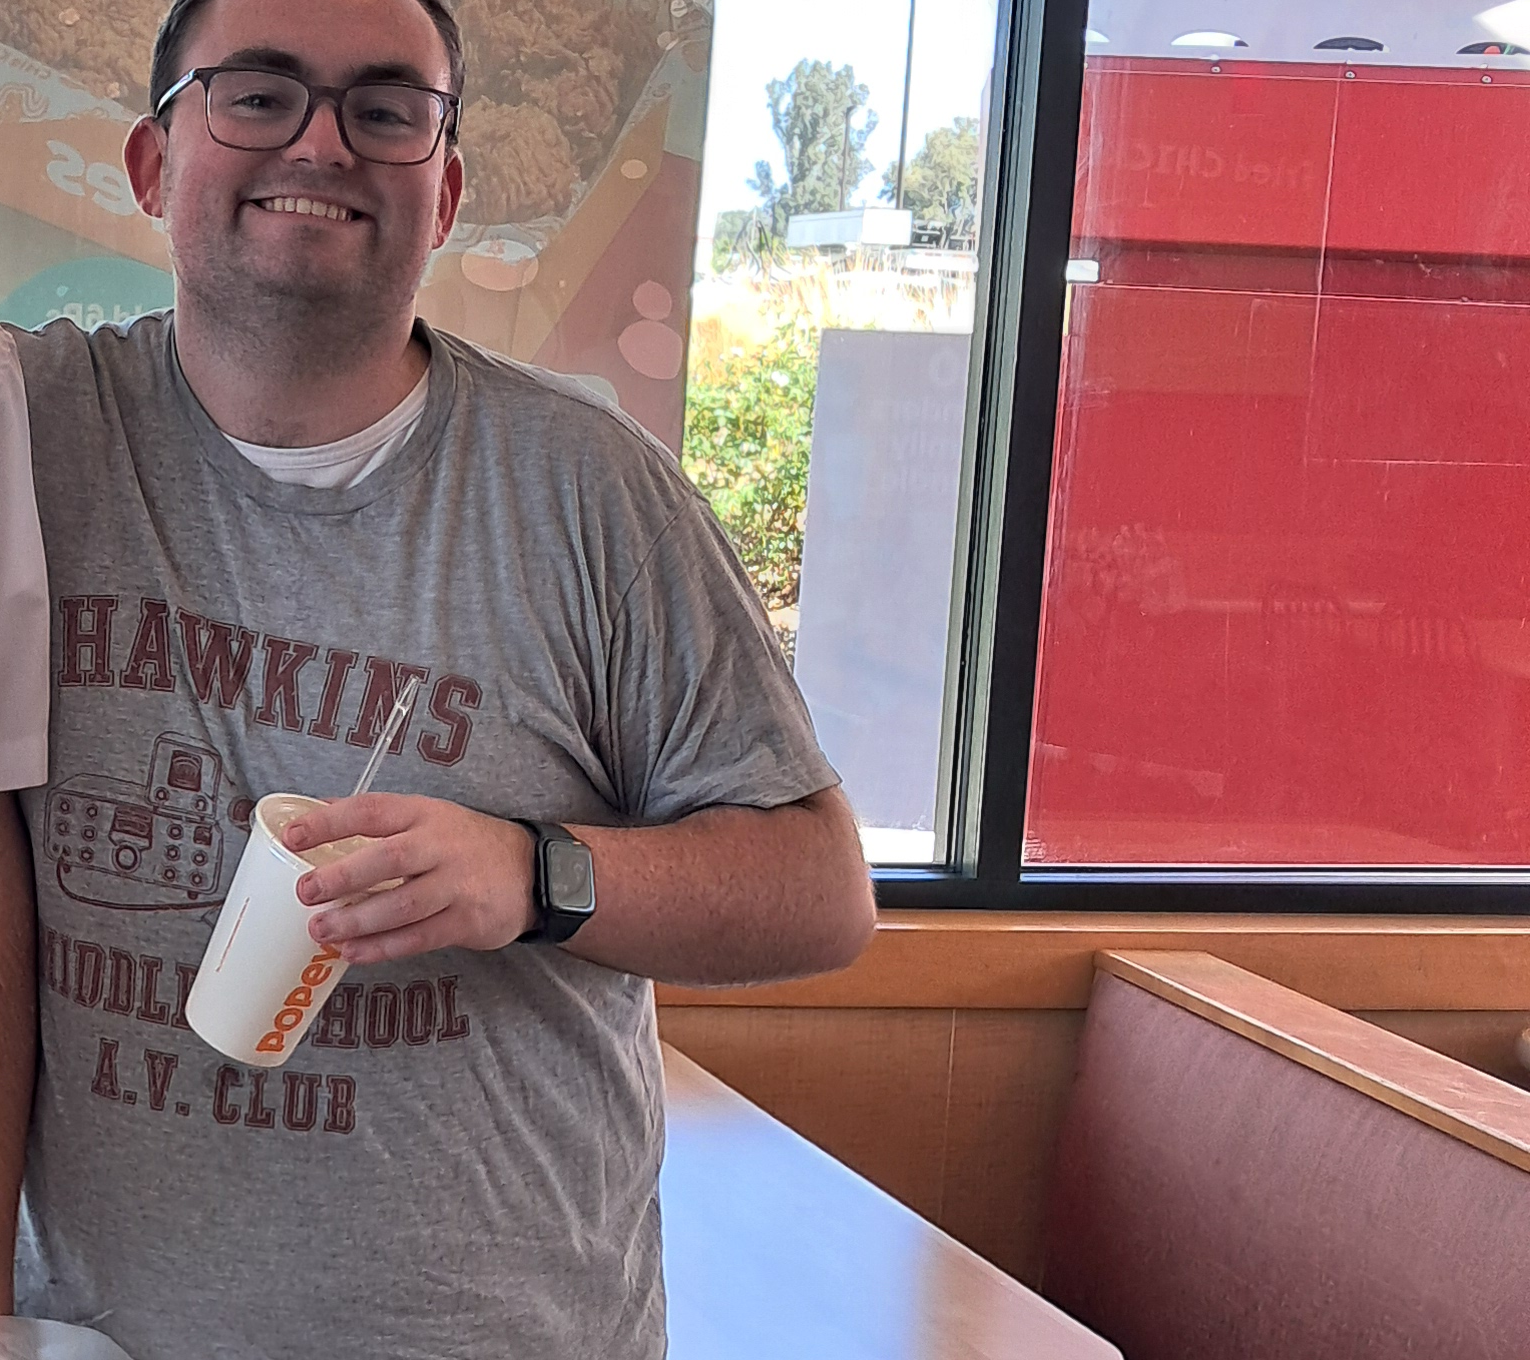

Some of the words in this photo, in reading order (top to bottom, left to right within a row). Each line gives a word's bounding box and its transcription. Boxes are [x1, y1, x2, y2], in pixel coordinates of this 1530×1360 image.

[57, 593, 484, 768] HAWKINS
[255, 943, 343, 1053] popey
[298, 975, 470, 1050] HOOL
[91, 1038, 191, 1117] A.V.
[213, 1064, 357, 1135] CLUB
